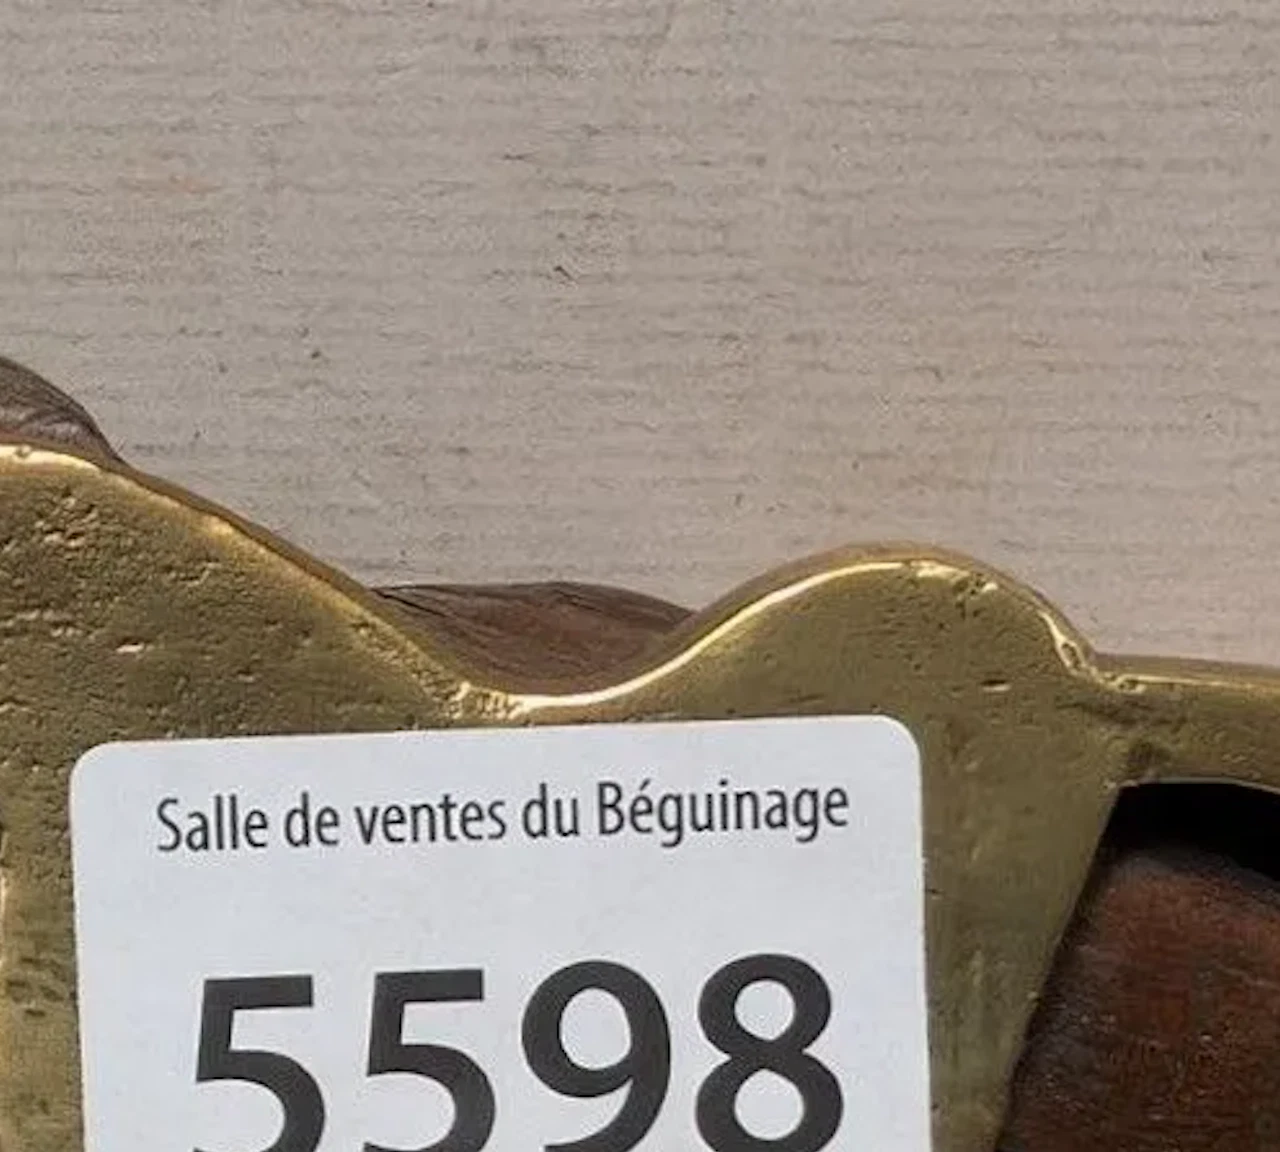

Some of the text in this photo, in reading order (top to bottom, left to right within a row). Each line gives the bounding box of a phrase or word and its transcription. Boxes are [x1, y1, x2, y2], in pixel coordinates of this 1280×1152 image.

[156, 777, 850, 853] Salle de ventes du Béguinage
